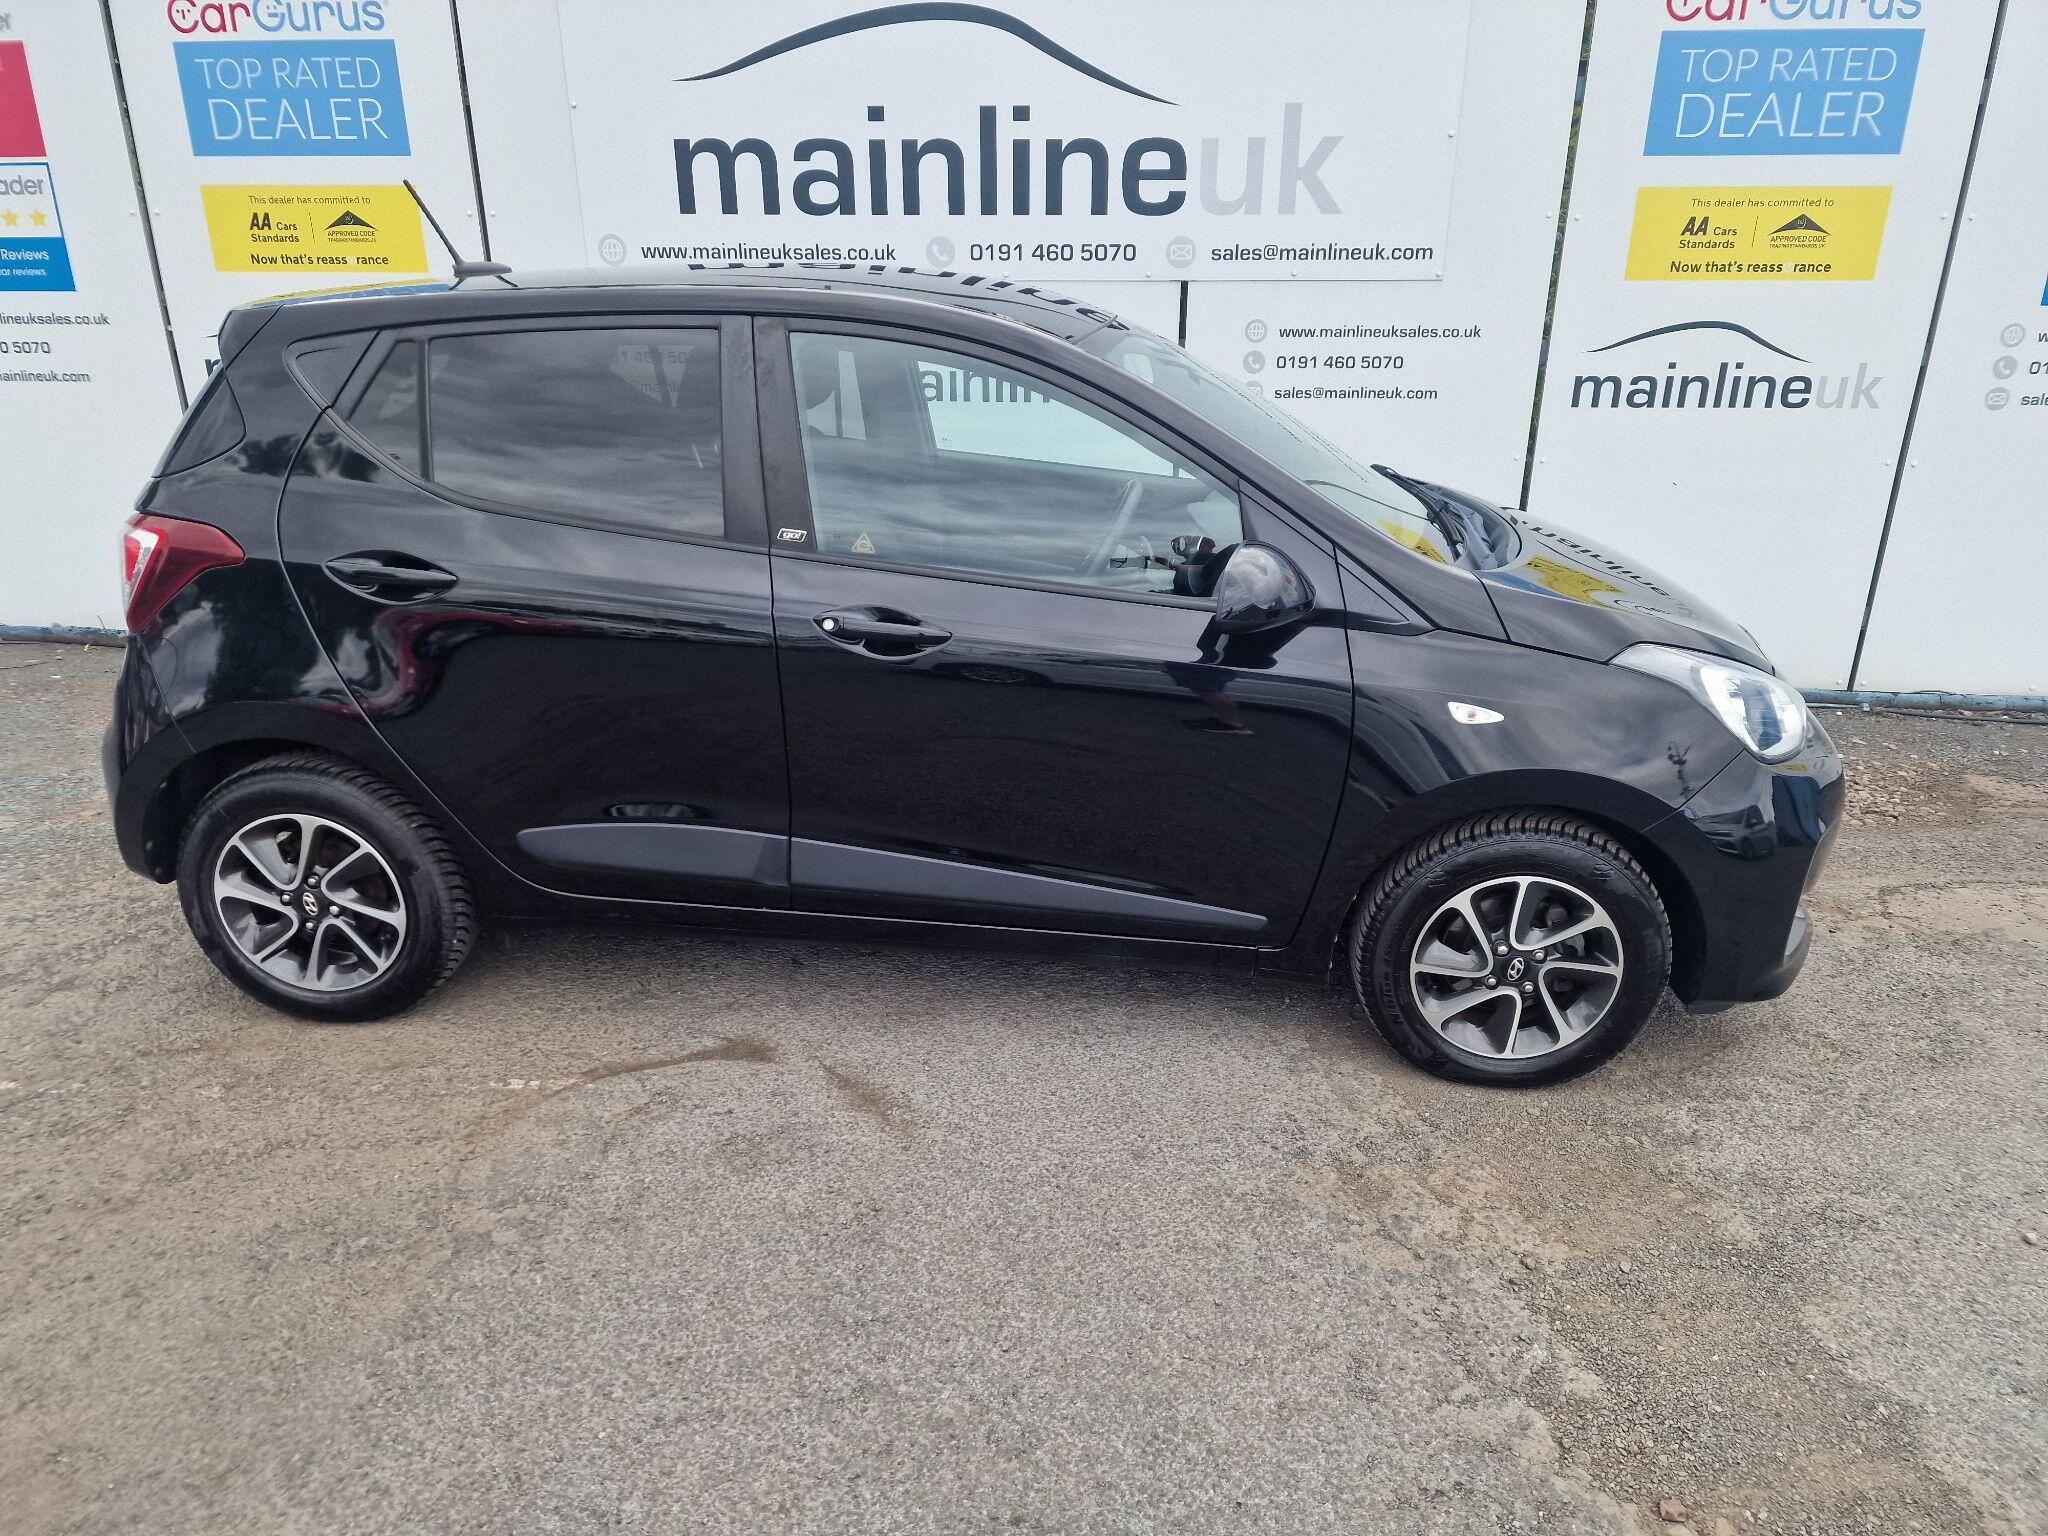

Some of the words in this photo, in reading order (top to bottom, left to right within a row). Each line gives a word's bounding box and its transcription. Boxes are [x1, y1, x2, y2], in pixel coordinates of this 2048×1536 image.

[167, 0, 386, 34] CarGurus
[1680, 48, 1760, 83] TOP
[1769, 47, 1898, 82] RATED
[194, 57, 263, 90] TOP
[273, 57, 382, 89] RATED
[207, 98, 389, 140] DEALER
[1675, 91, 1886, 138] DEALER
[248, 195, 267, 205] This
[268, 195, 295, 205] dealer
[297, 195, 312, 205] has
[314, 195, 360, 205] committed
[361, 196, 371, 205] to
[1691, 198, 1712, 208] This
[1714, 198, 1746, 208] dealer
[1747, 198, 1765, 208] has
[1767, 198, 1822, 208] committed
[1824, 198, 1835, 208] to
[249, 211, 272, 231] AA
[276, 222, 298, 231] Cars
[1680, 216, 1710, 236] AA
[1713, 226, 1738, 236] Cars
[250, 233, 300, 243] Standards
[1679, 239, 1736, 249] Standards
[0, 248, 50, 261] Reviews
[250, 253, 278, 265] Now
[316, 255, 389, 265] reassrance
[641, 242, 897, 262] www.mainlineuksales.co.uk
[969, 243, 1024, 262] 0191
[1031, 243, 1075, 262] 460
[1080, 243, 1138, 262] 5070
[1210, 243, 1434, 262] sales@mainlineuk.com
[1669, 261, 1702, 273] Now
[1746, 262, 1832, 273] reassrance
[1278, 324, 1482, 338] www.mainlineuksales.co.uk
[12, 341, 51, 354] 5070
[1276, 355, 1318, 370] 0191
[1323, 355, 1356, 370] 460
[1360, 355, 1404, 370] 5070
[1274, 386, 1438, 400] sales@mainlineuk.com
